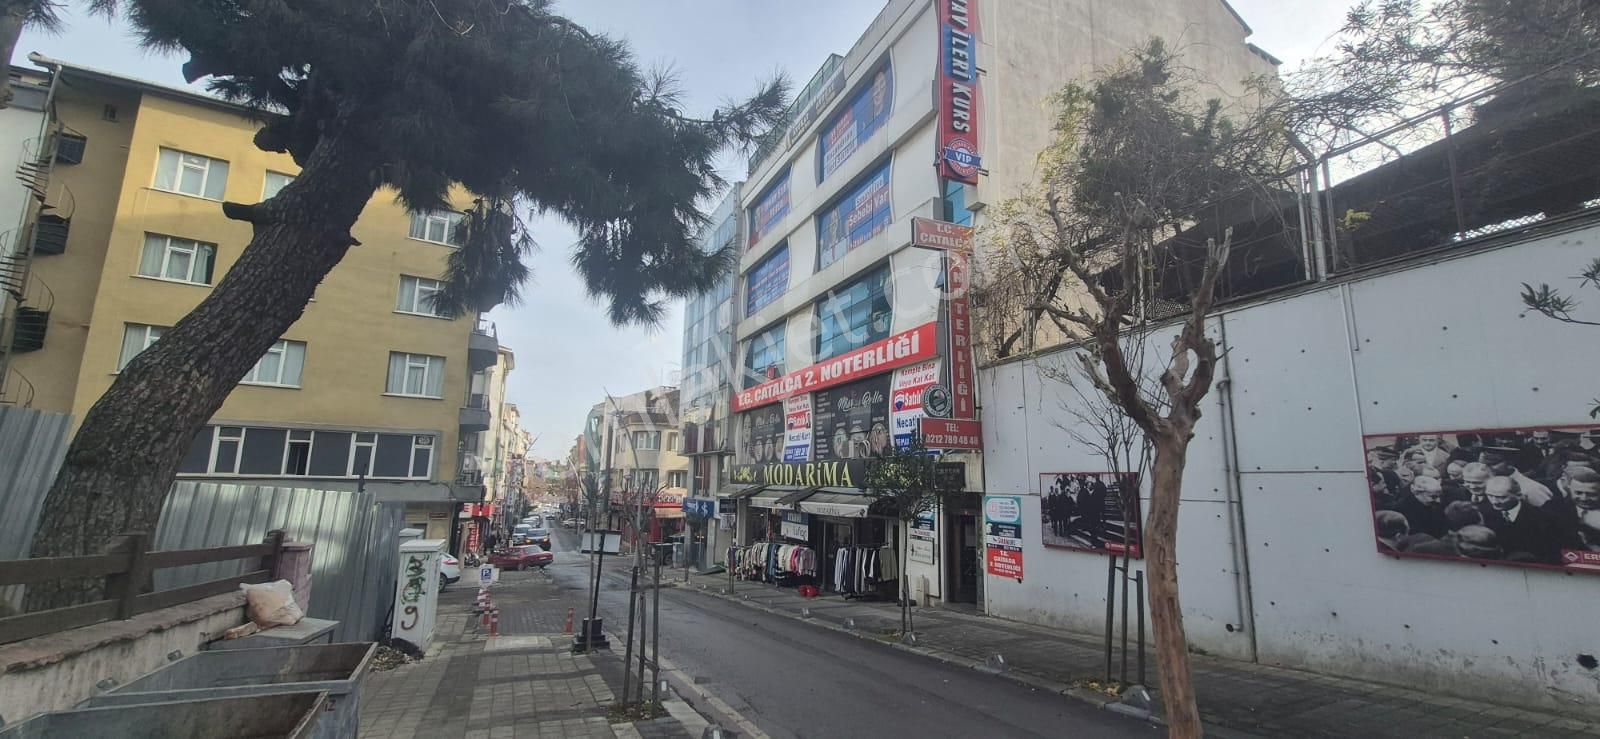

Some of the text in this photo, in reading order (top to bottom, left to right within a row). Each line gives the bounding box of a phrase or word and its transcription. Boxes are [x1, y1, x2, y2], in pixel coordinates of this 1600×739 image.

[951, 0, 969, 28] AV
[951, 28, 972, 80] İLERİ
[953, 82, 971, 133] KURS
[954, 151, 973, 164] VIP
[805, 370, 818, 387] 2.
[820, 330, 920, 382] NOTERLİĞİ
[945, 422, 959, 433] TEL:
